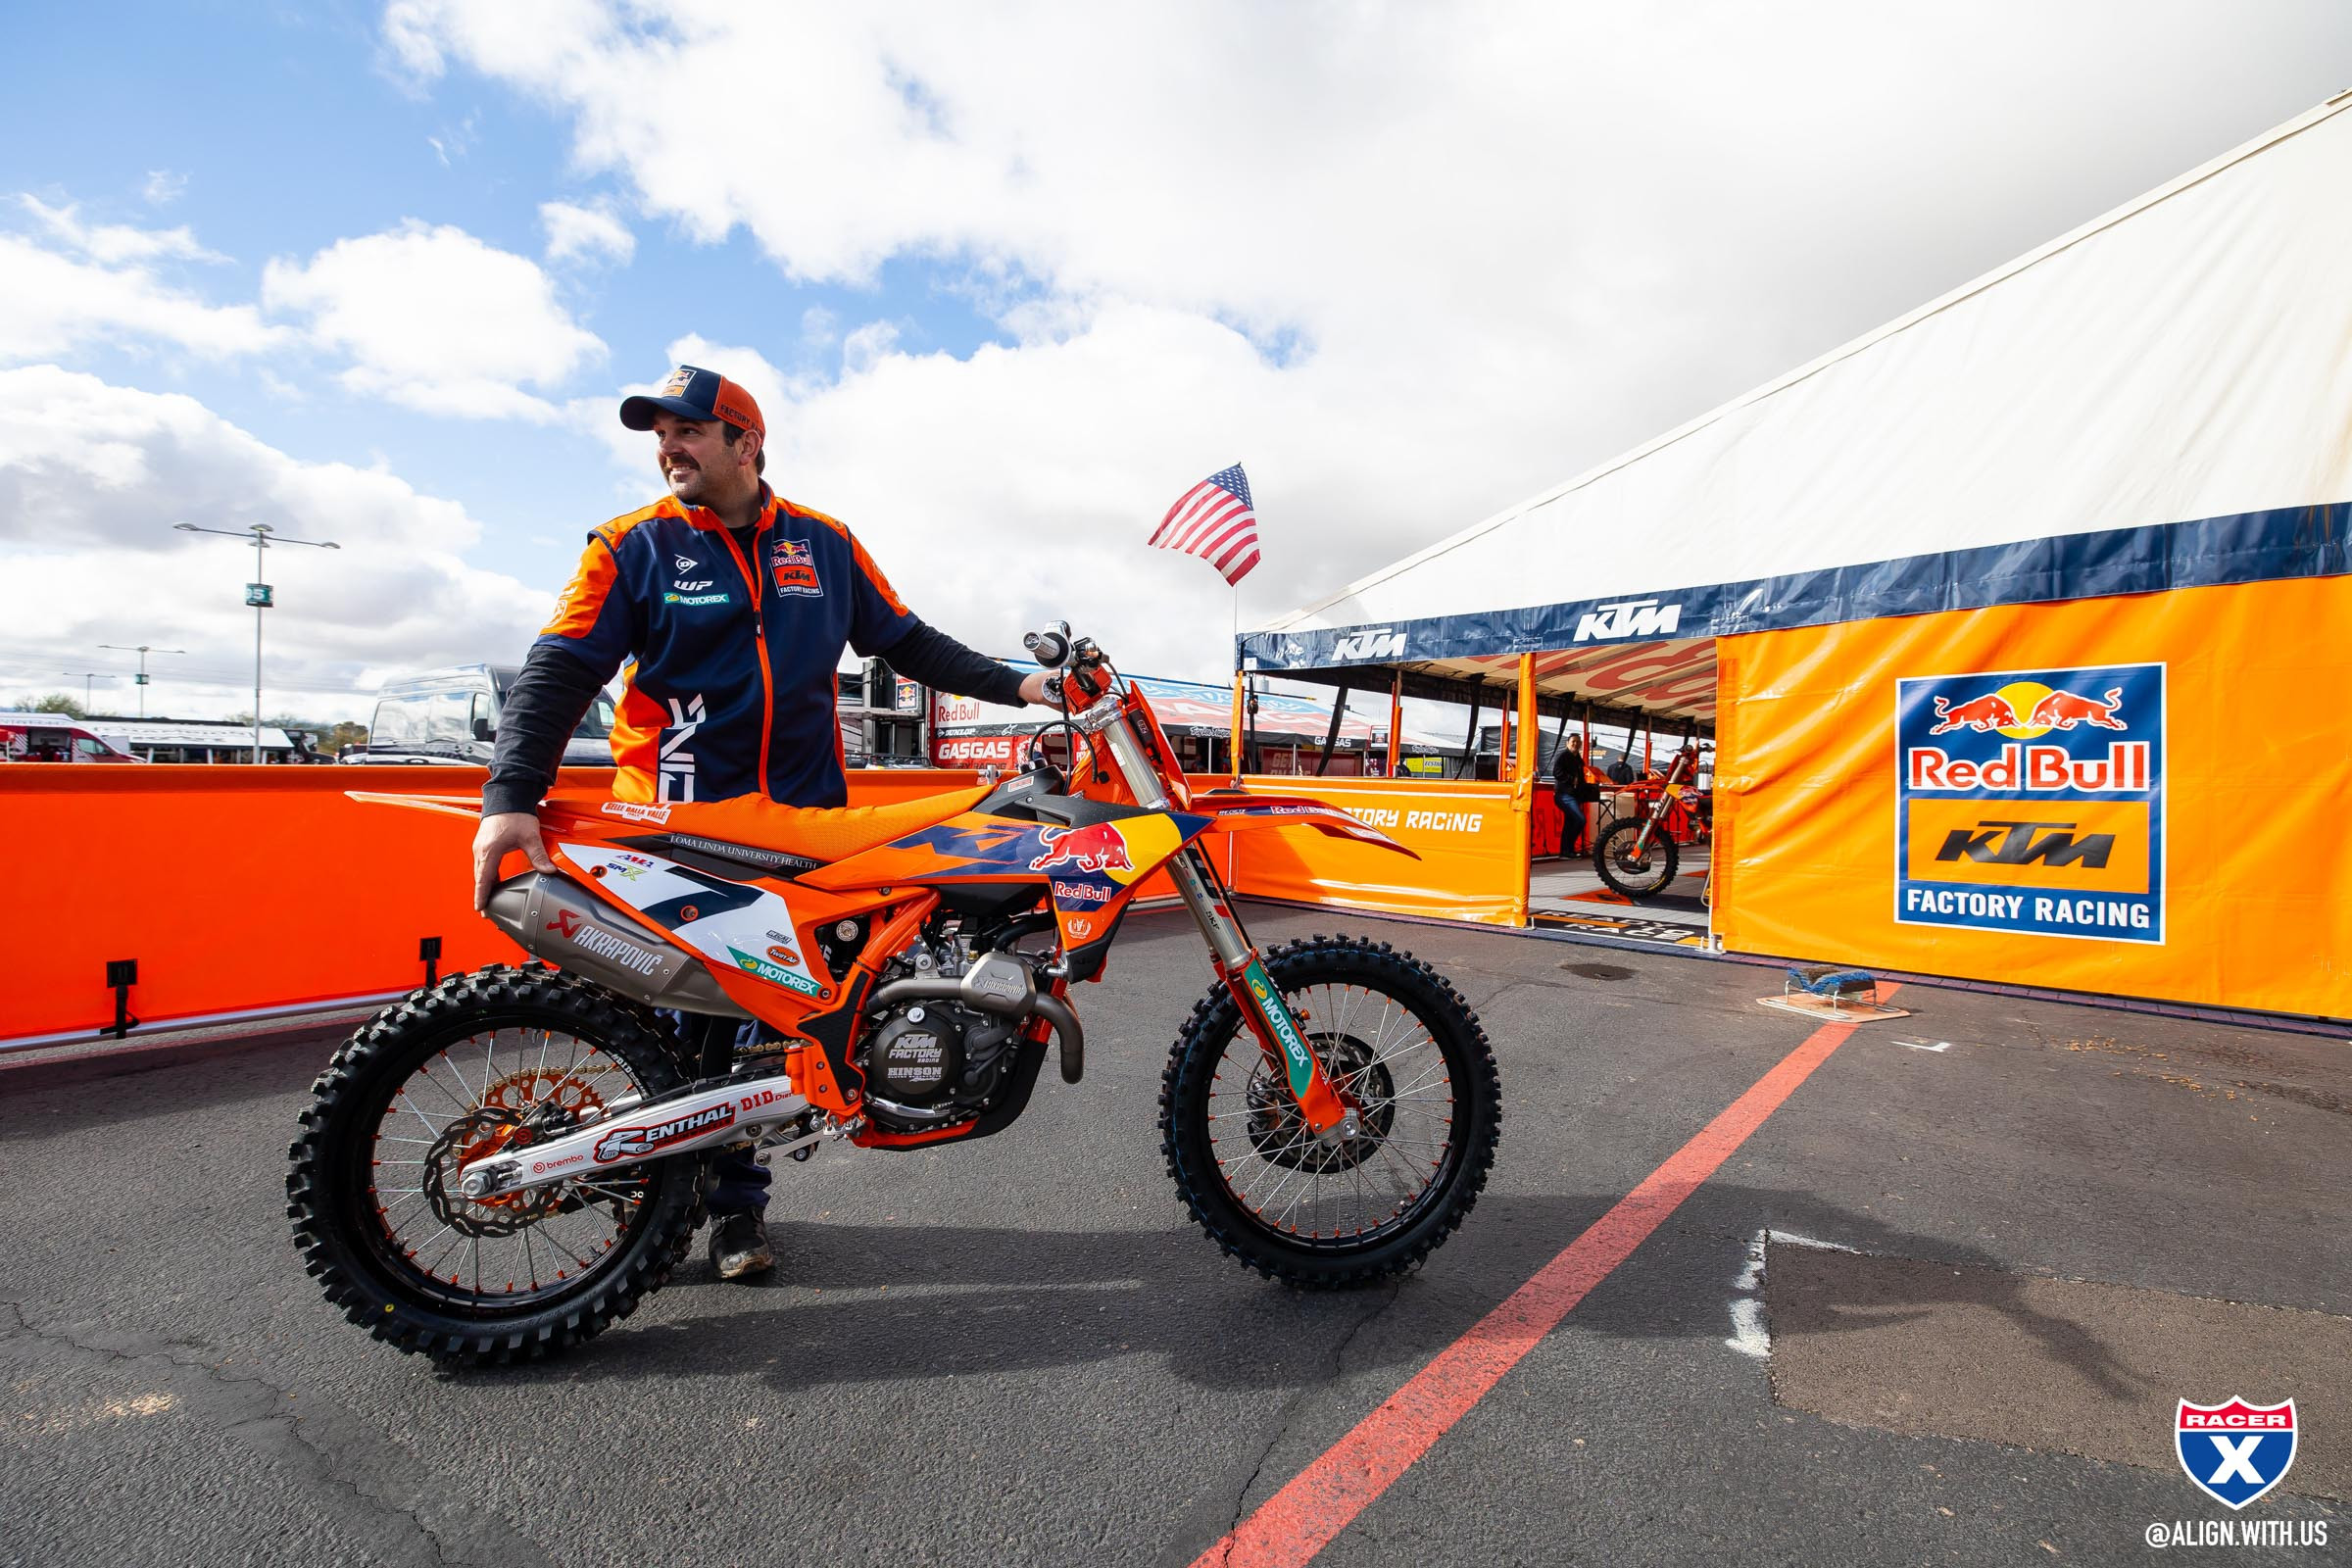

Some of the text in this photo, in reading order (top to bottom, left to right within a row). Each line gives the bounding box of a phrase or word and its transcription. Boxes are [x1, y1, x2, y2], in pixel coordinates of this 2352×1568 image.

[720, 404, 751, 425] FACTORY
[771, 554, 813, 566] Red Bull
[784, 570, 810, 581] KTM
[674, 580, 713, 591] WP
[803, 586, 820, 595] RACING
[680, 594, 727, 605] MOTOREX
[1573, 599, 1682, 642] KTM
[1332, 628, 1407, 662] KTM
[938, 702, 980, 722] Red Bull
[938, 741, 1010, 760] GASGAS
[1908, 741, 2150, 792] Red Bull
[606, 803, 667, 820] SELLE DALLA VALLE
[1270, 806, 1304, 815] Red
[670, 835, 817, 870] LOMA LINDA UNIVERSITY HEALTH
[1935, 820, 2116, 869] KTM
[1054, 881, 1112, 903] Red Bull
[1906, 888, 2150, 929] FACTORY RACING
[1206, 910, 1220, 930] SKF
[1564, 923, 1687, 941] RACE
[769, 948, 786, 960] Twin
[757, 963, 816, 995] MOTOREX
[894, 1033, 938, 1049] KTM
[1261, 997, 1309, 1068] MOTOREX
[888, 1048, 943, 1059] FACTORY
[887, 1066, 943, 1076] HINSON
[546, 1154, 584, 1169] brembo
